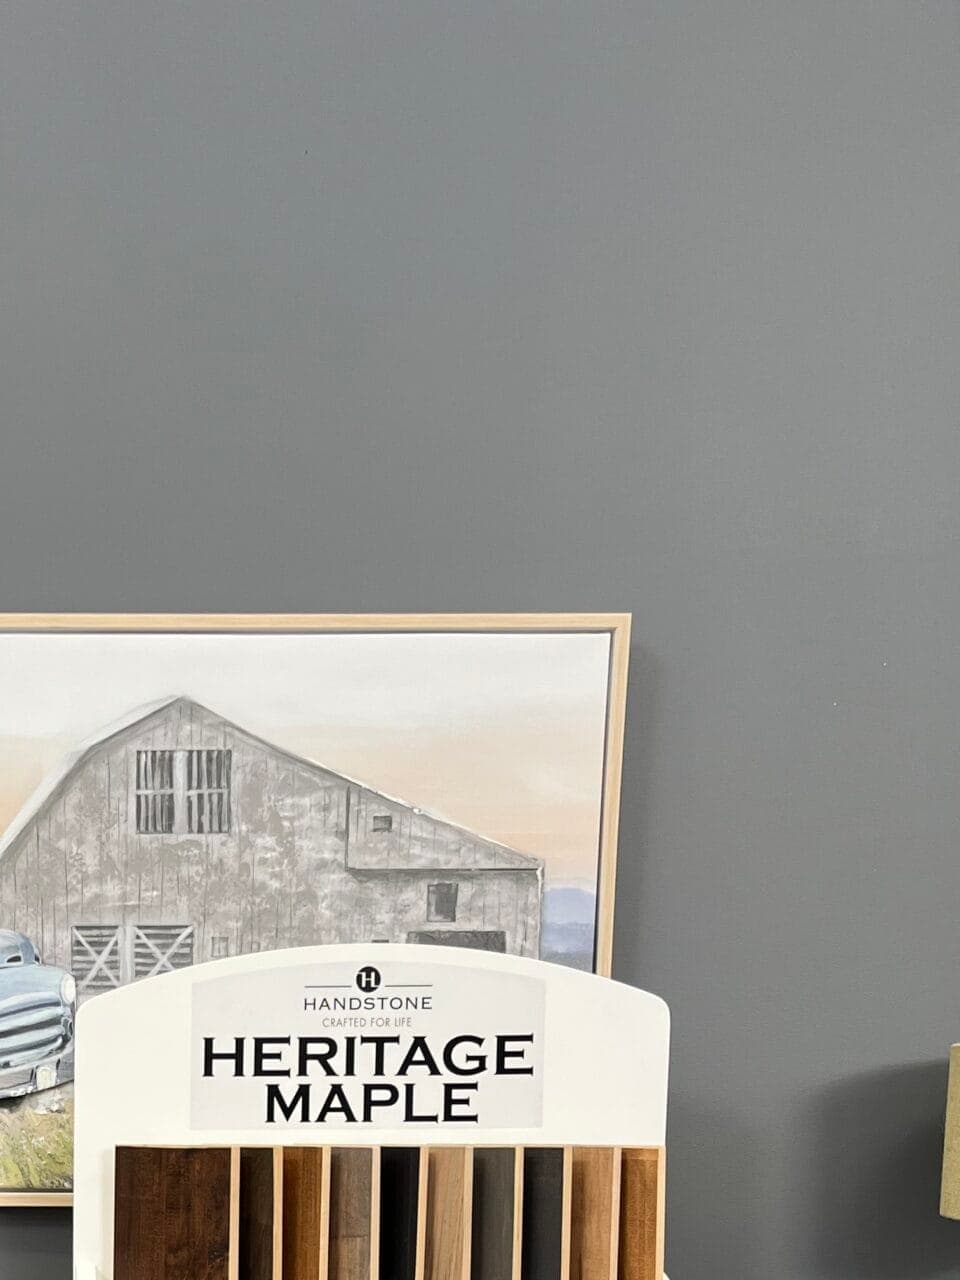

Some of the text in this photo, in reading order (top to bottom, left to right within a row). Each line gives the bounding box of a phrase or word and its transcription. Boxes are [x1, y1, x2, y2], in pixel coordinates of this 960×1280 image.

[304, 996, 433, 1011] HANDSTONE
[322, 1017, 412, 1028] CRAFTED FOR LIFE
[202, 1033, 534, 1078] HERITAGE
[265, 1082, 479, 1123] MAPLE
